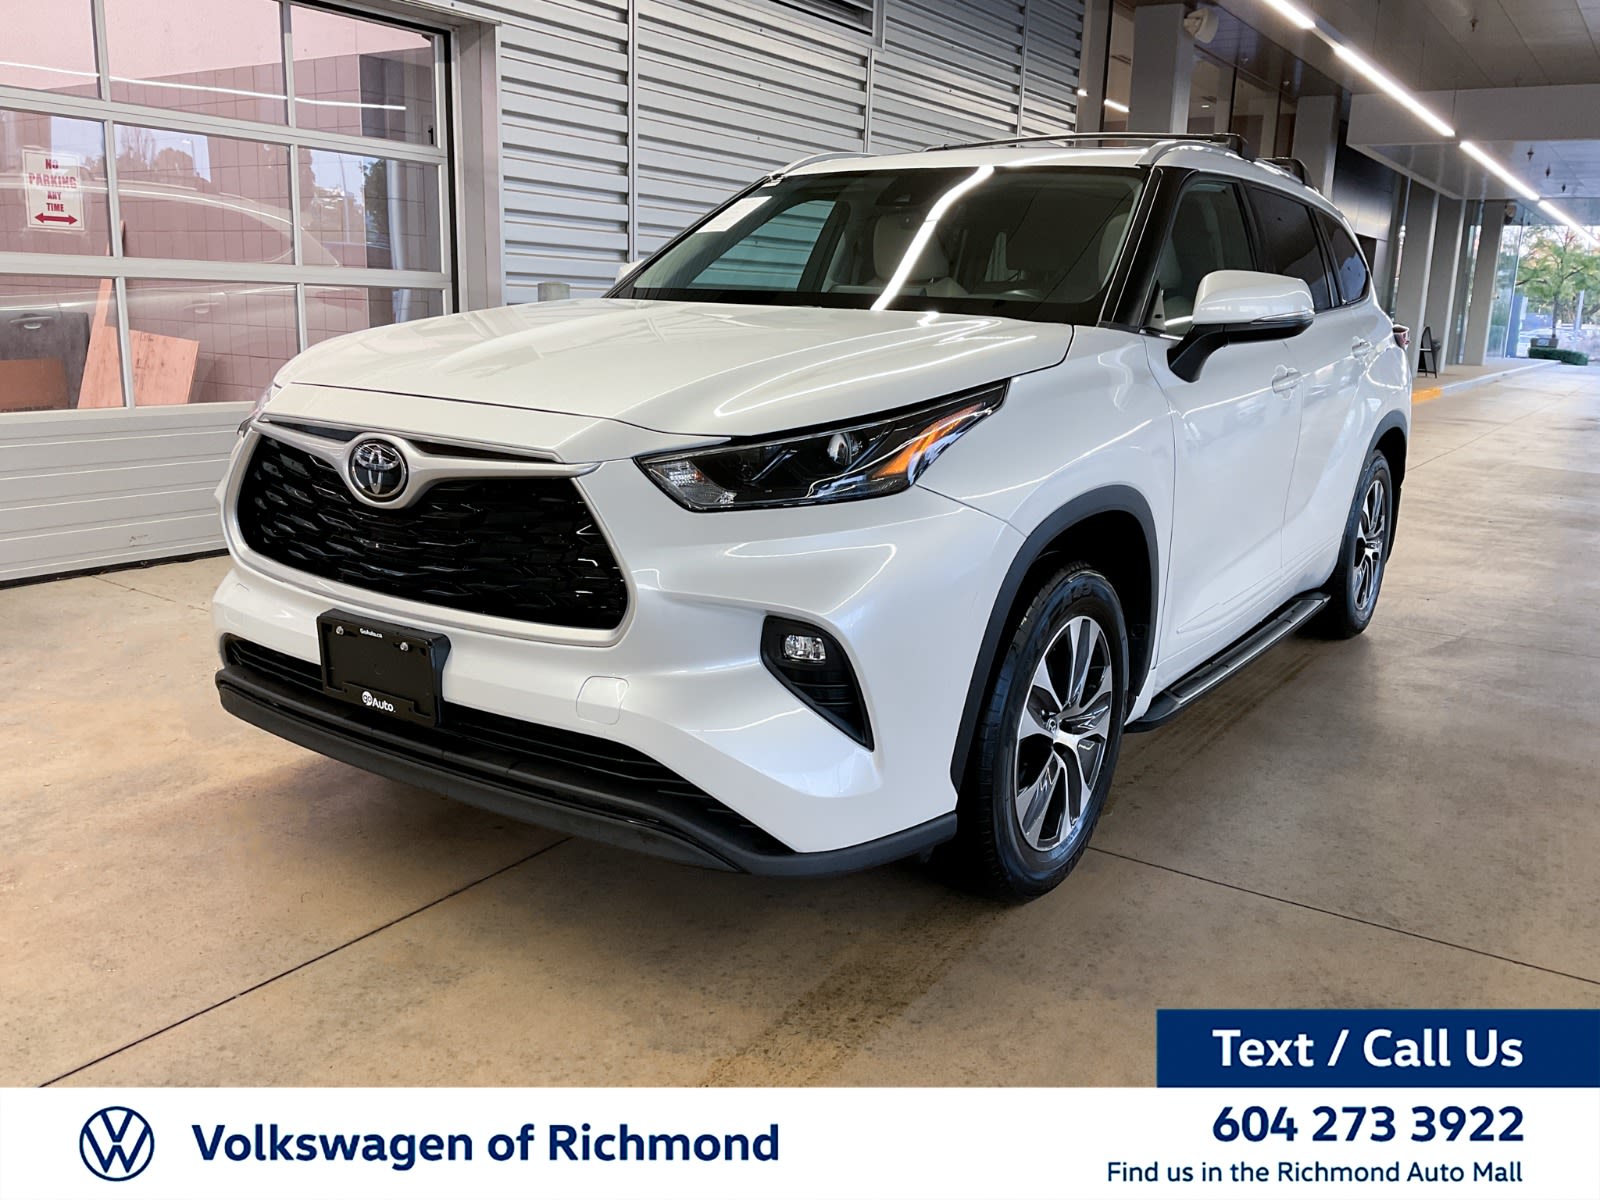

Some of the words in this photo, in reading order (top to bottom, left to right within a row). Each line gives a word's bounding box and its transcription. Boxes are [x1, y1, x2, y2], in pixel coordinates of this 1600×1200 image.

[28, 172, 77, 188] PARKING
[47, 191, 61, 200] ANY
[46, 203, 64, 212] TIME
